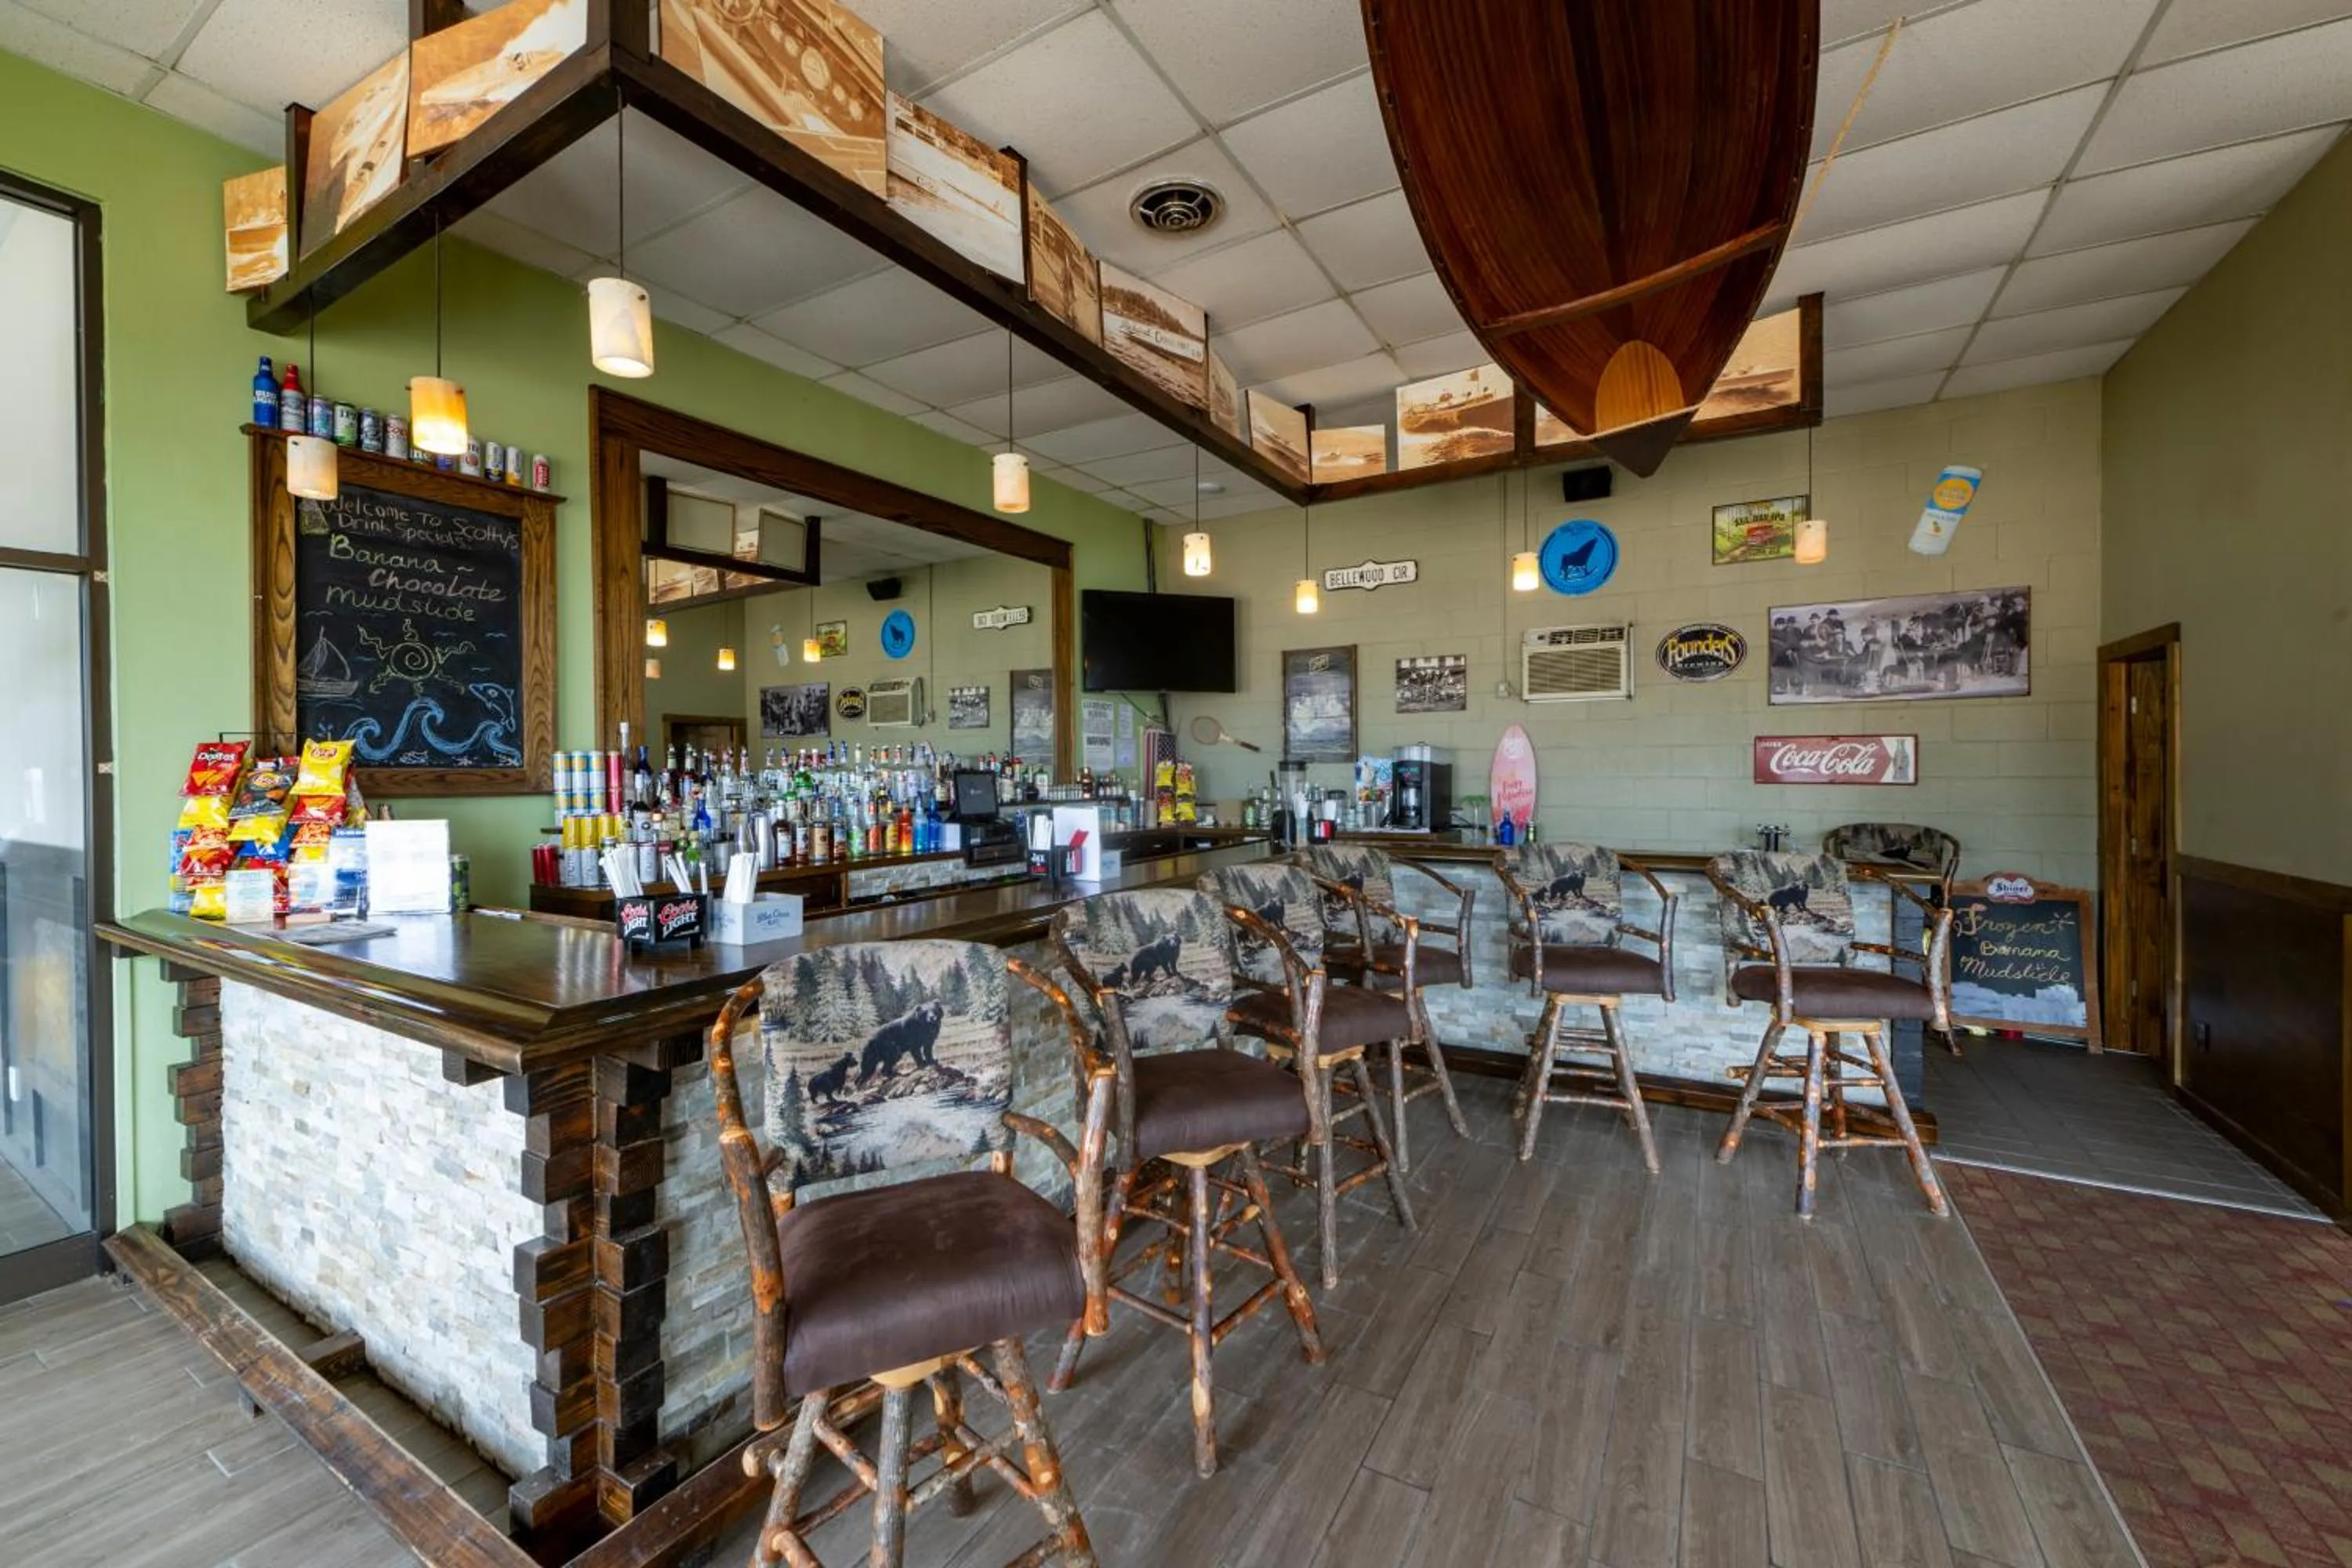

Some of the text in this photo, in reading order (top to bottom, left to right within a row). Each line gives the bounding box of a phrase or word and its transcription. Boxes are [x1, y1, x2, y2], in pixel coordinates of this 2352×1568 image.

[322, 495, 411, 522] Welcome
[338, 512, 391, 534] Drink
[329, 533, 445, 574] Banana
[1329, 568, 1385, 586] BELLEWOOD
[198, 750, 235, 761] Doritos
[1995, 881, 2029, 894] Shiner
[620, 902, 649, 924] Coors
[657, 899, 699, 926] Coors
[1953, 903, 2056, 942] Frozen
[662, 911, 699, 939] LIGHT
[1980, 940, 2071, 962] Banana
[1959, 955, 2071, 985] Mudslide
